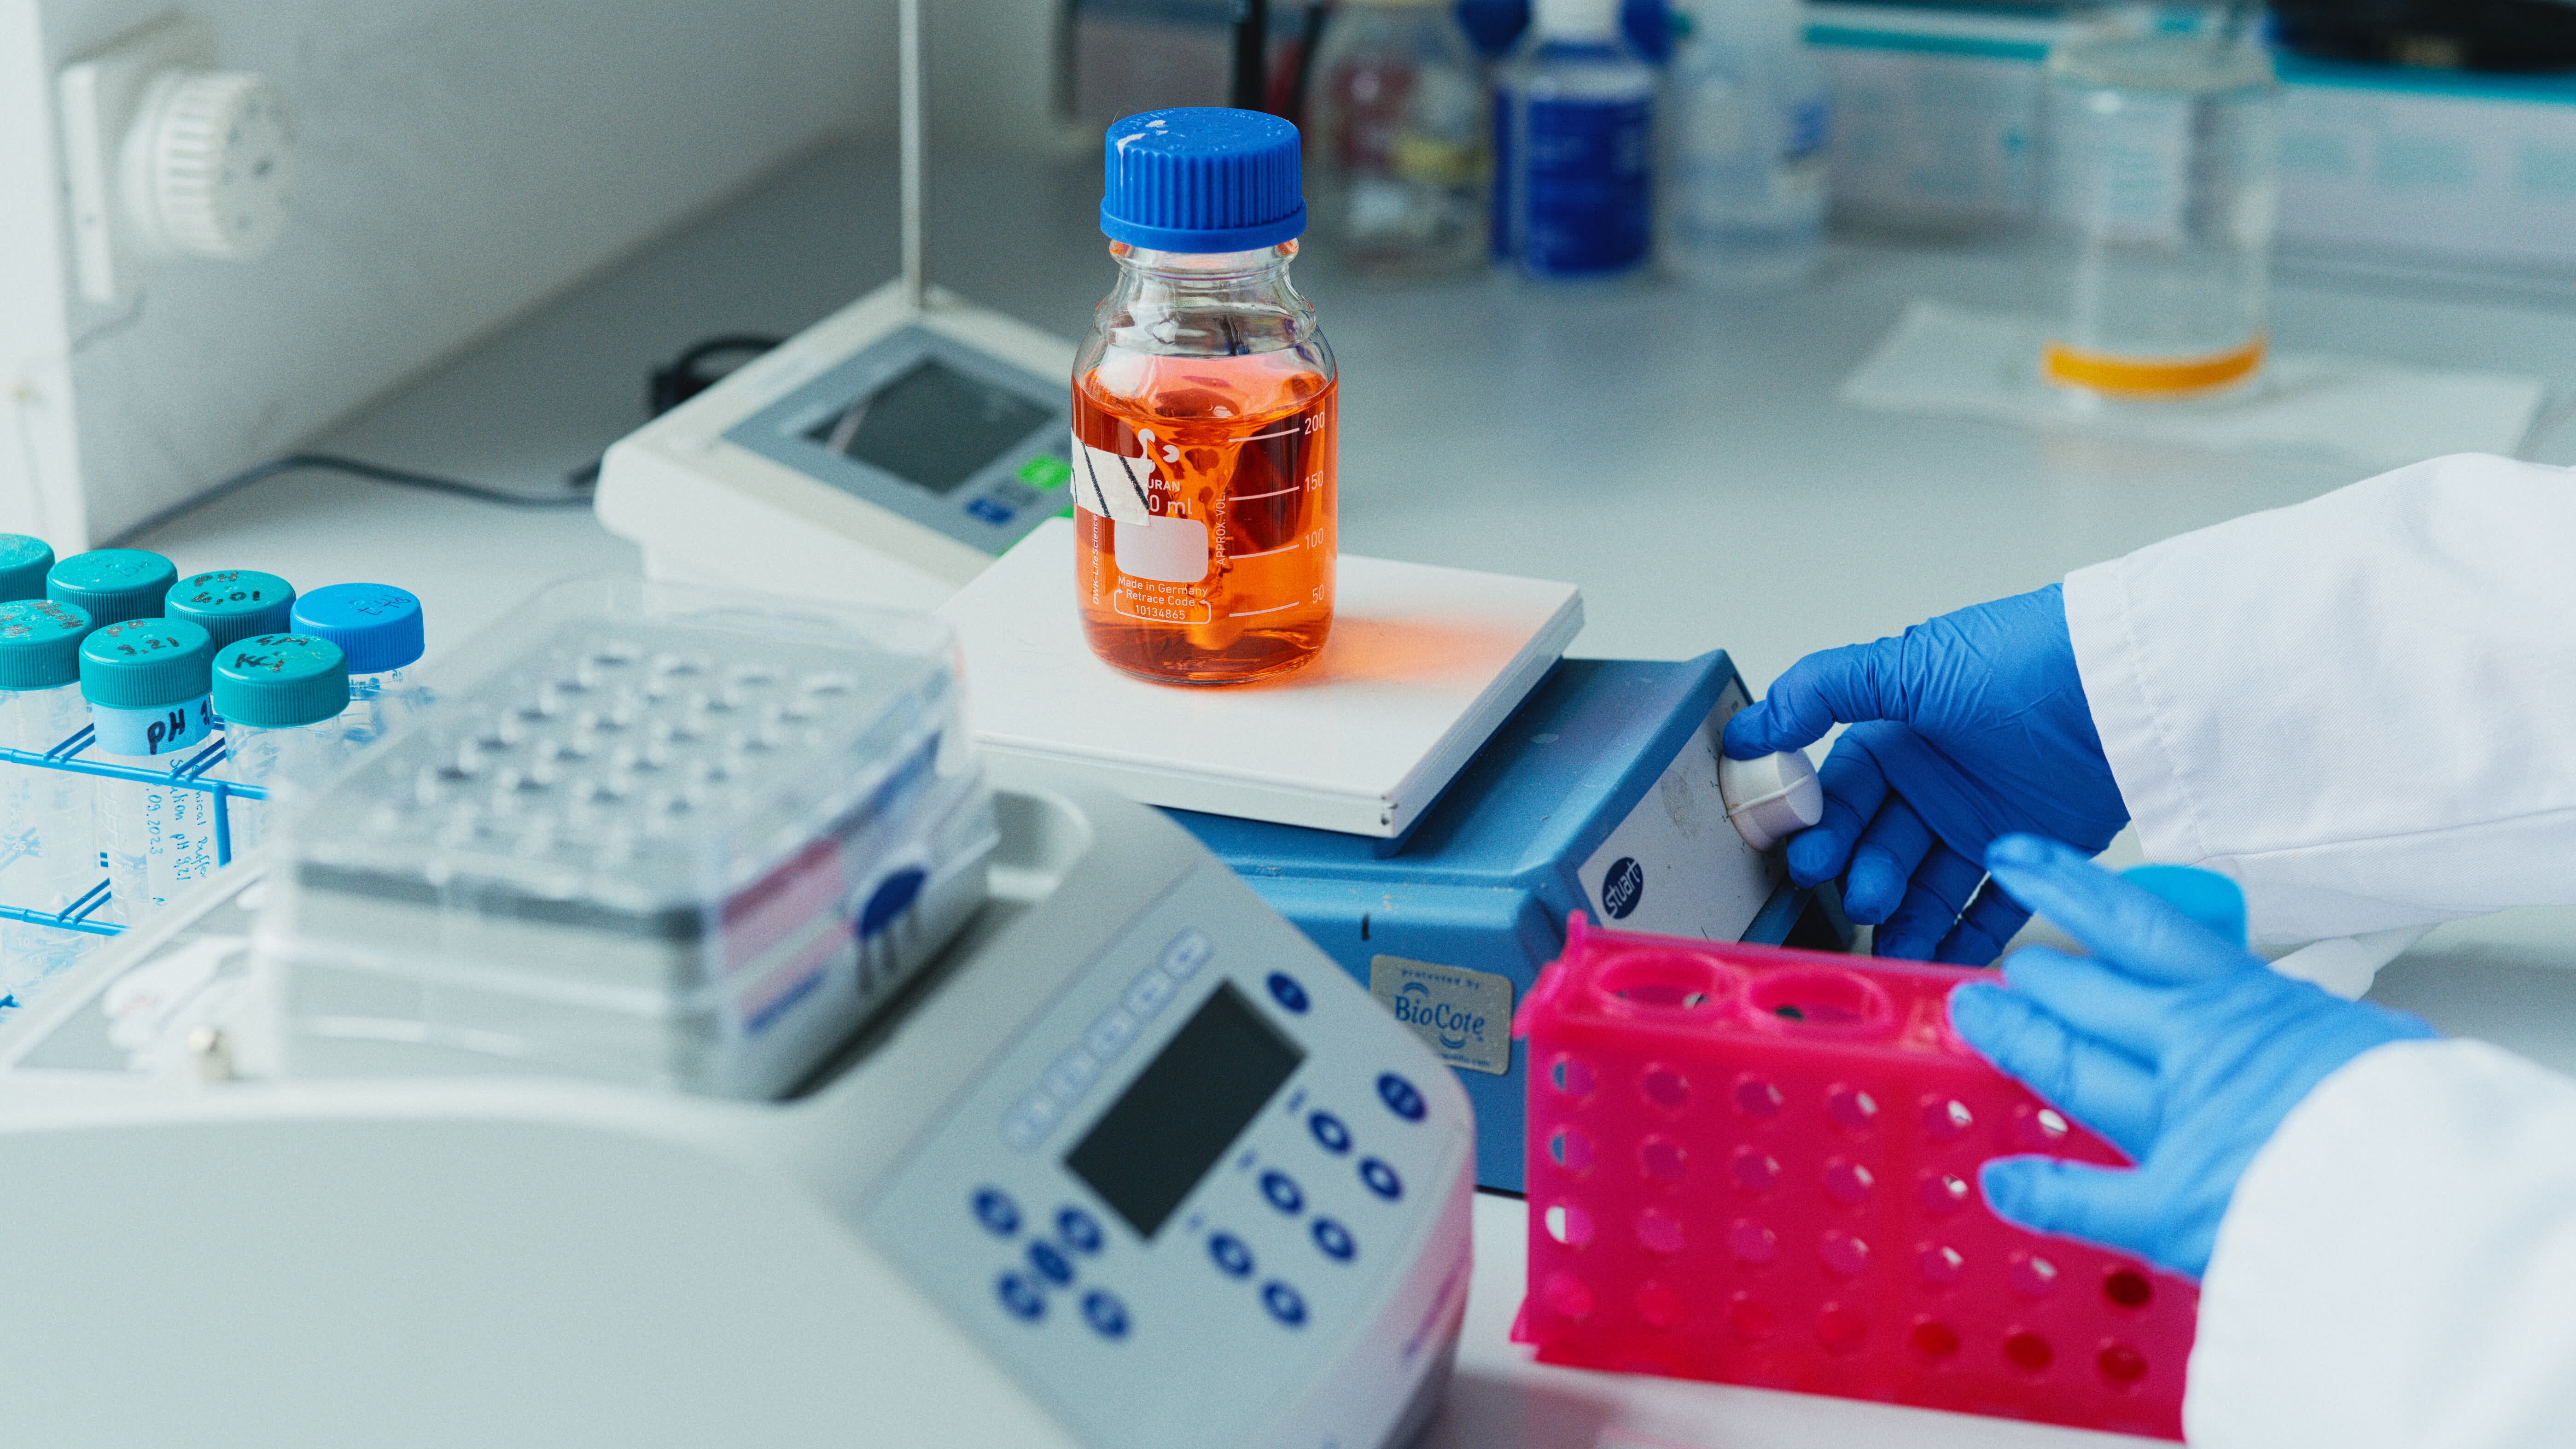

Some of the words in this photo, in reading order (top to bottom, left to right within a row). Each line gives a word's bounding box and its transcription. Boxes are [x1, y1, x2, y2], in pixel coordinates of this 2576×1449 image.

[1305, 411, 1325, 435] 200
[1148, 479, 1180, 491] URAN
[1305, 470, 1323, 492] 150
[1149, 495, 1160, 513] 0
[1167, 497, 1193, 515] ml
[1216, 492, 1226, 516] VOL.
[1216, 519, 1226, 566] APPROX.
[1305, 528, 1323, 549] 100
[1118, 575, 1143, 590] Made
[1146, 582, 1155, 591] in
[1158, 584, 1208, 597] Germany
[1312, 584, 1324, 604] 50
[1126, 589, 1165, 604] Retrace
[1168, 596, 1195, 607] Code
[1135, 605, 1186, 619] 10134865
[146, 782, 163, 855] .09.2023
[1395, 995, 1485, 1035] BioCote
